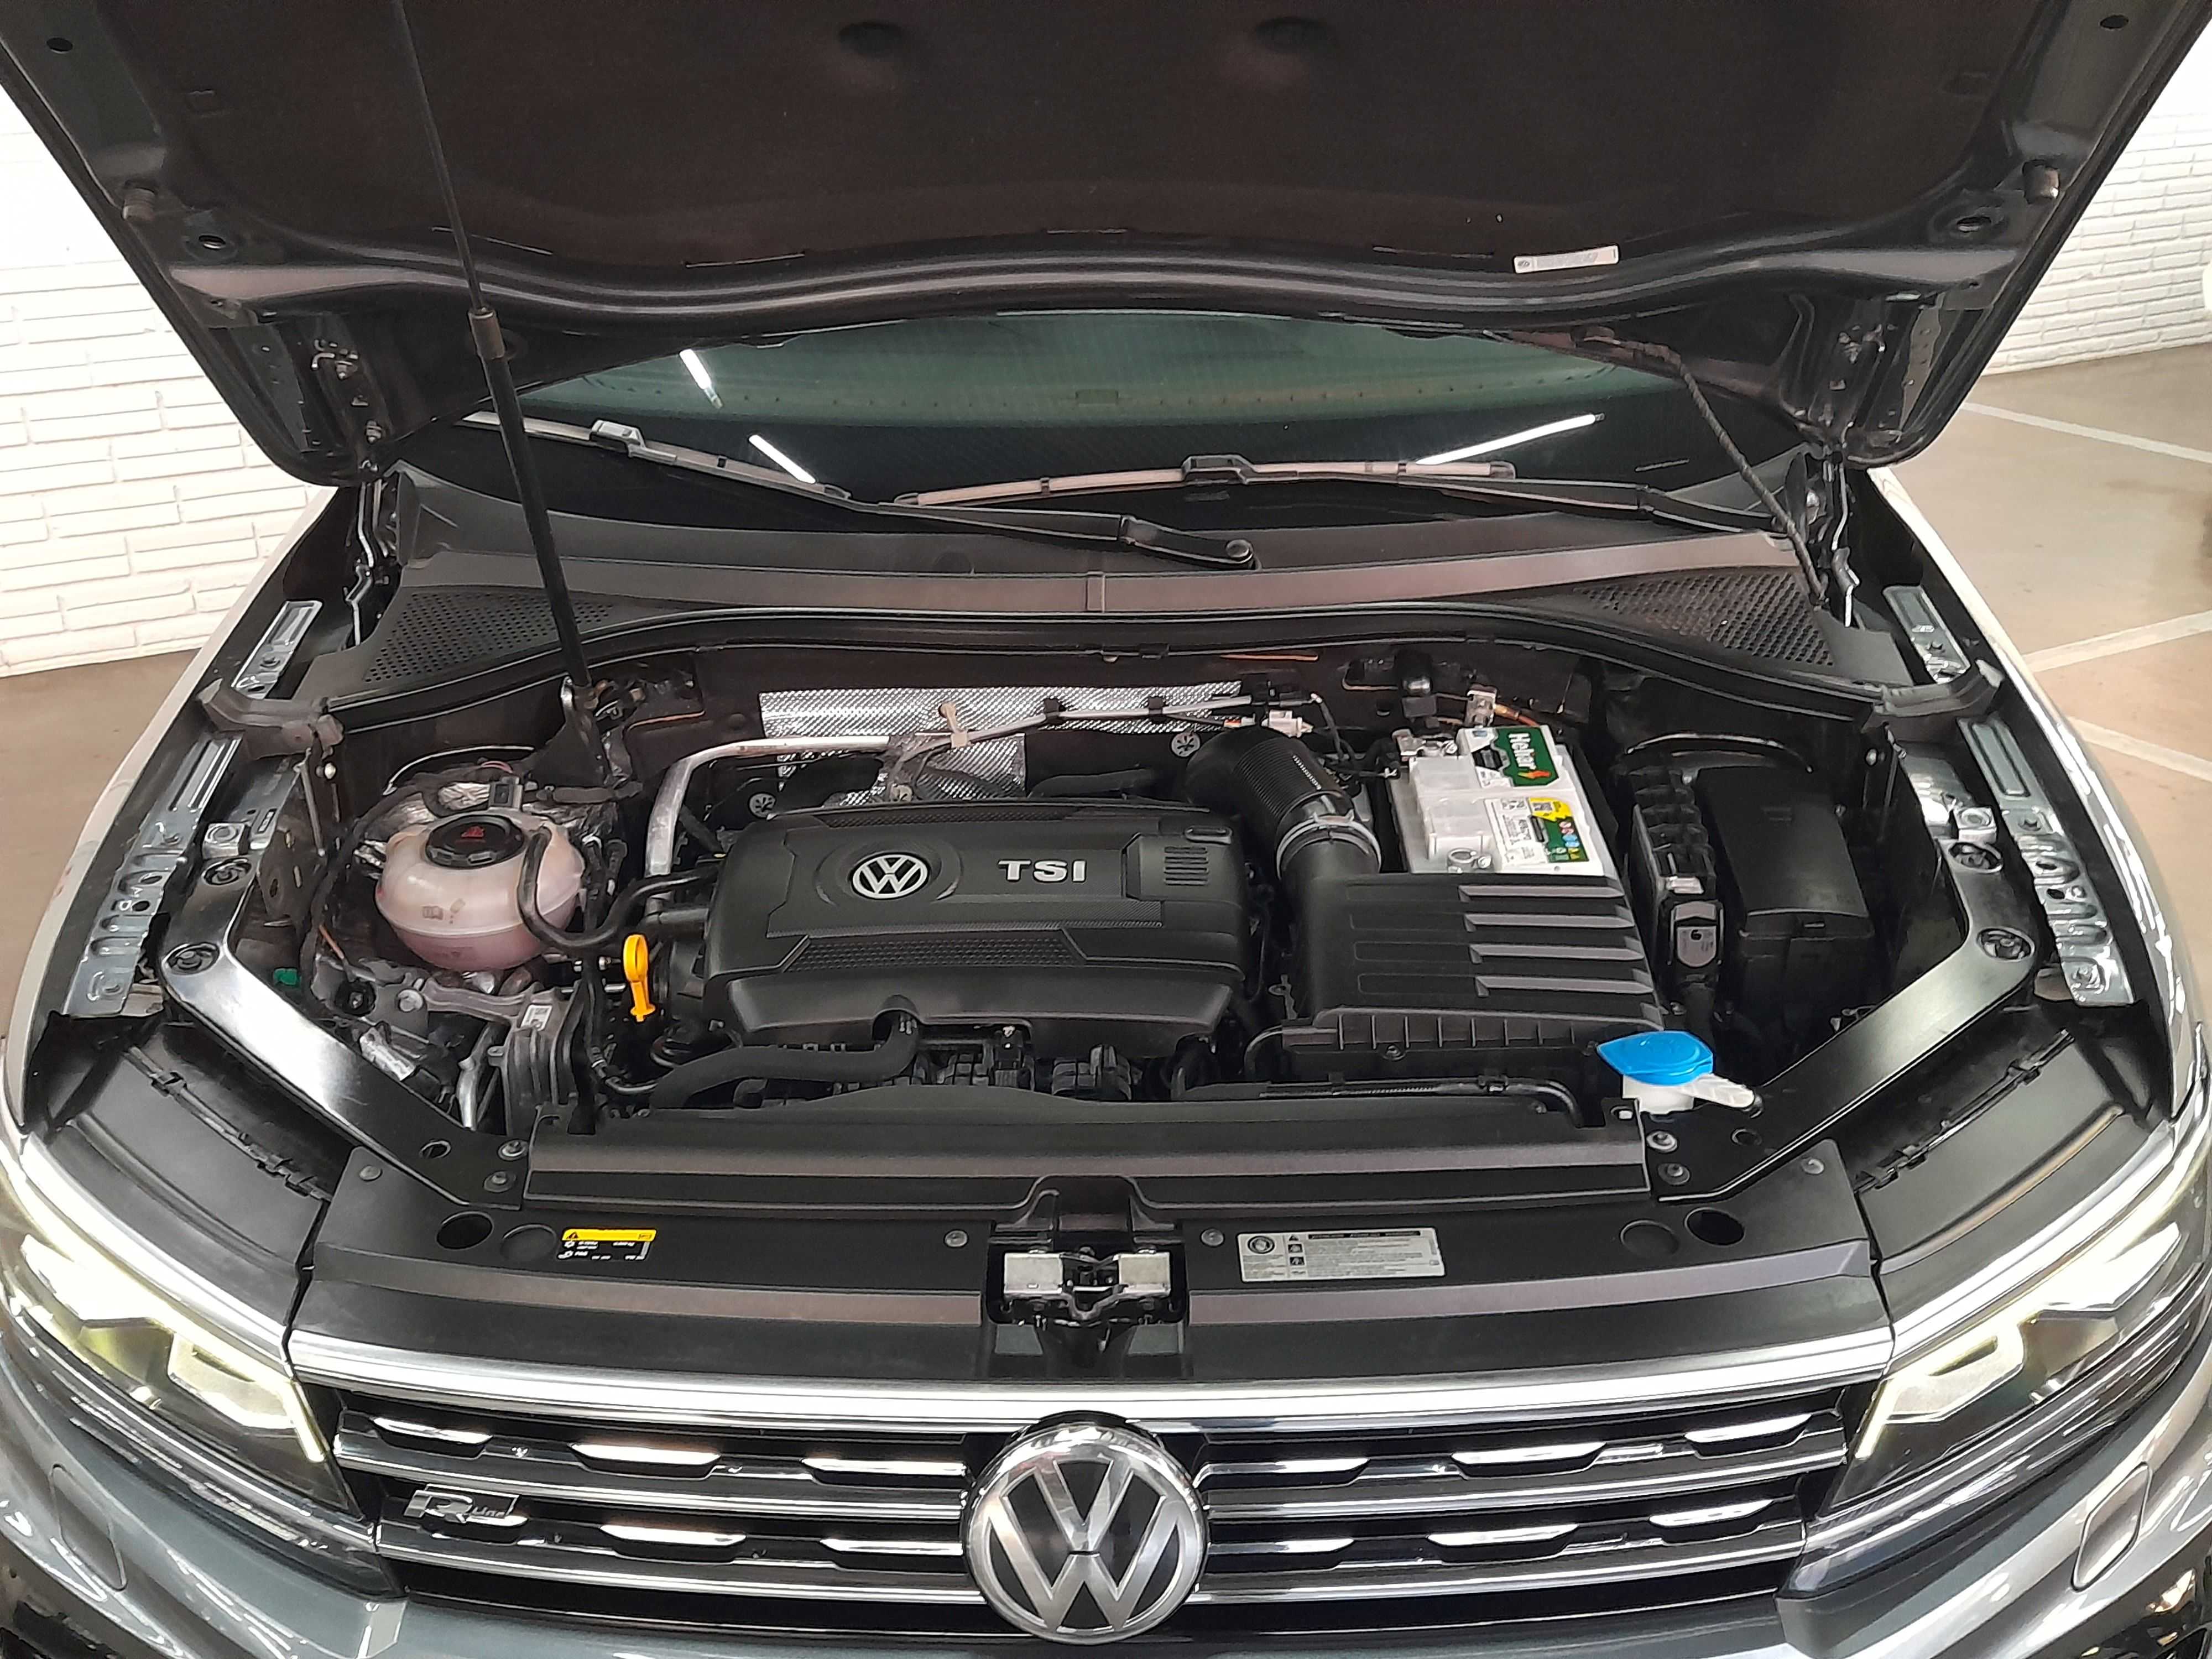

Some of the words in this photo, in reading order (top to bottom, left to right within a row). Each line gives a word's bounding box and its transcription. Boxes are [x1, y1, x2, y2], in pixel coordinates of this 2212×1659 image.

[1508, 733, 1537, 770] Heliar
[999, 859, 1087, 883] TSI
[1691, 929, 1702, 941] 6
[968, 1427, 1203, 1642] VW
